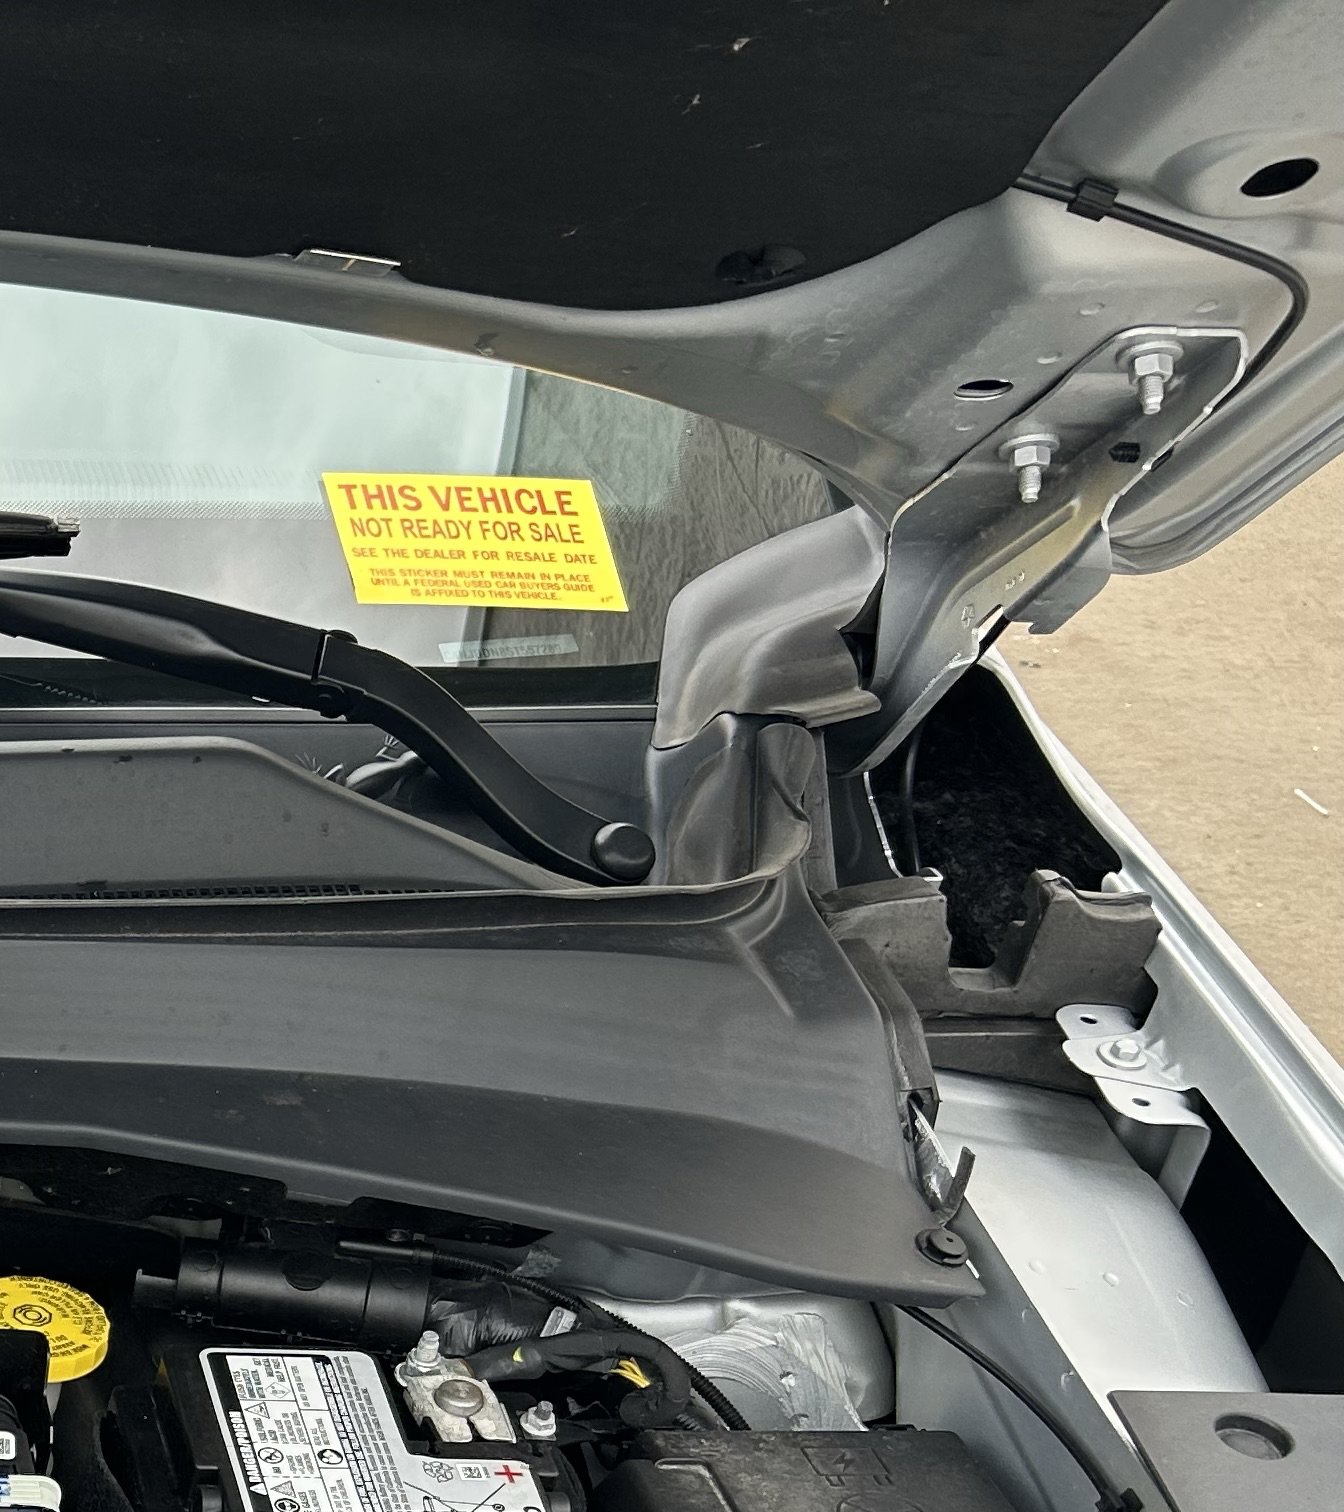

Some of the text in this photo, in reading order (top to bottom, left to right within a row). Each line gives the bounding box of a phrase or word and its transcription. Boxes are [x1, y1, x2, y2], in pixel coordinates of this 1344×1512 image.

[337, 483, 579, 517] THIS VEHICLE
[349, 518, 584, 544] NOT READY FOR SALE
[352, 547, 597, 565] SEE THE DEALER FOR RESALE DATE
[369, 568, 591, 582] THIS STICKER MUST REMAIN IN PLACE
[402, 578, 411, 586] A
[414, 578, 461, 588] FEDERAL
[464, 580, 491, 589] USED
[495, 580, 517, 590] CAR
[519, 582, 561, 591] BUYERS
[563, 583, 595, 593] GUIDE
[472, 590, 486, 598] TO
[489, 590, 512, 599] THIS
